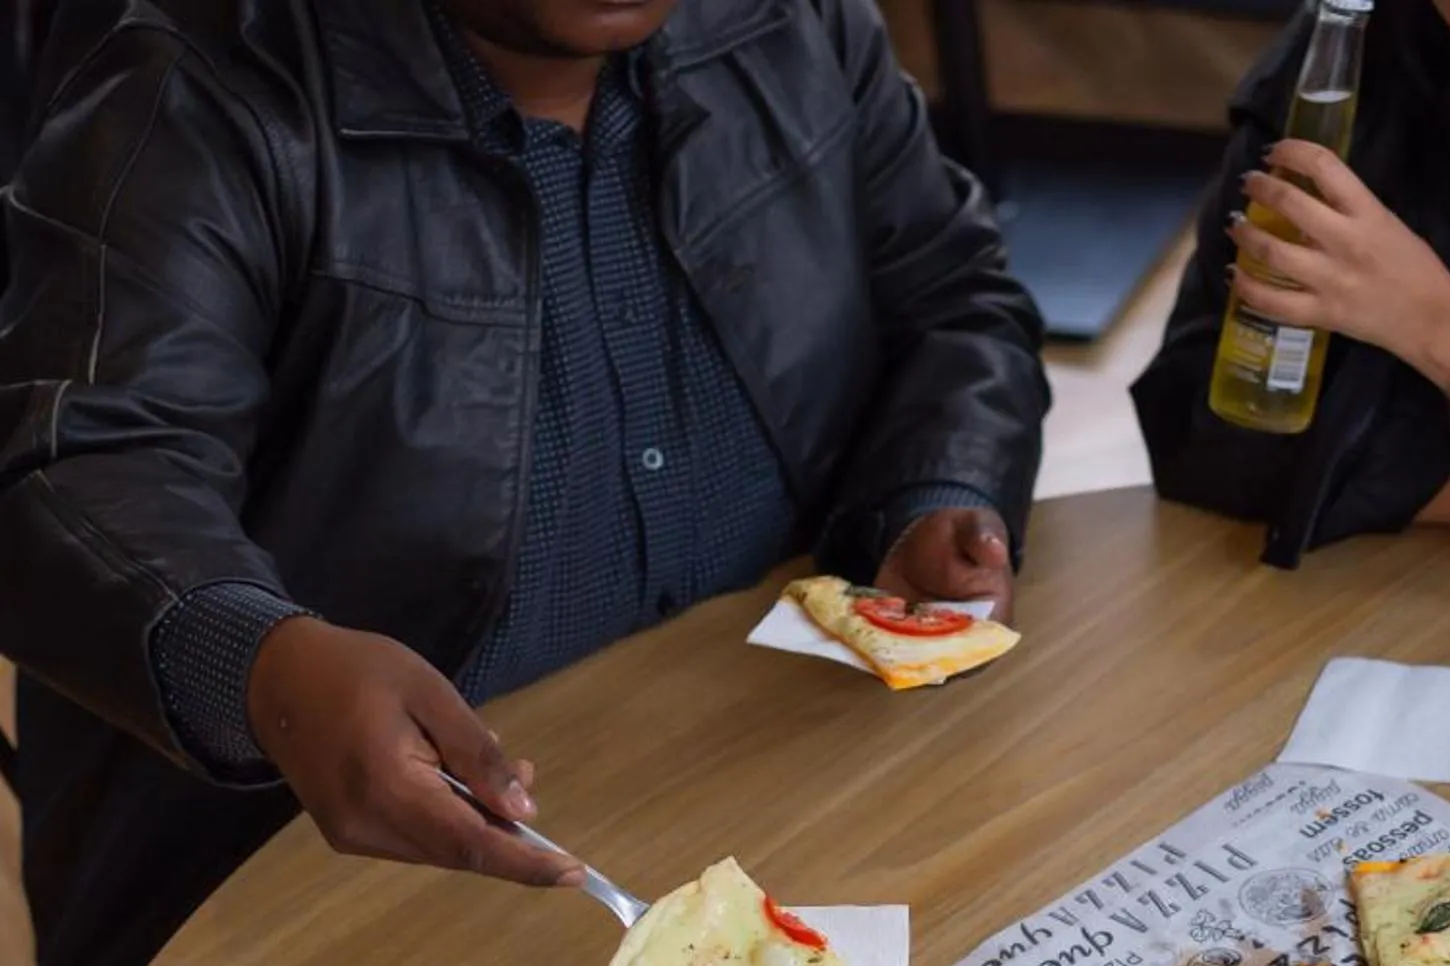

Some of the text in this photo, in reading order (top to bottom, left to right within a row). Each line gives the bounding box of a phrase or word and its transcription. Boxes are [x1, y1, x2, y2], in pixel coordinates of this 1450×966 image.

[1299, 790, 1384, 838] fossem
[1342, 809, 1433, 867] pessoas
[1109, 843, 1257, 934] PIZZA
